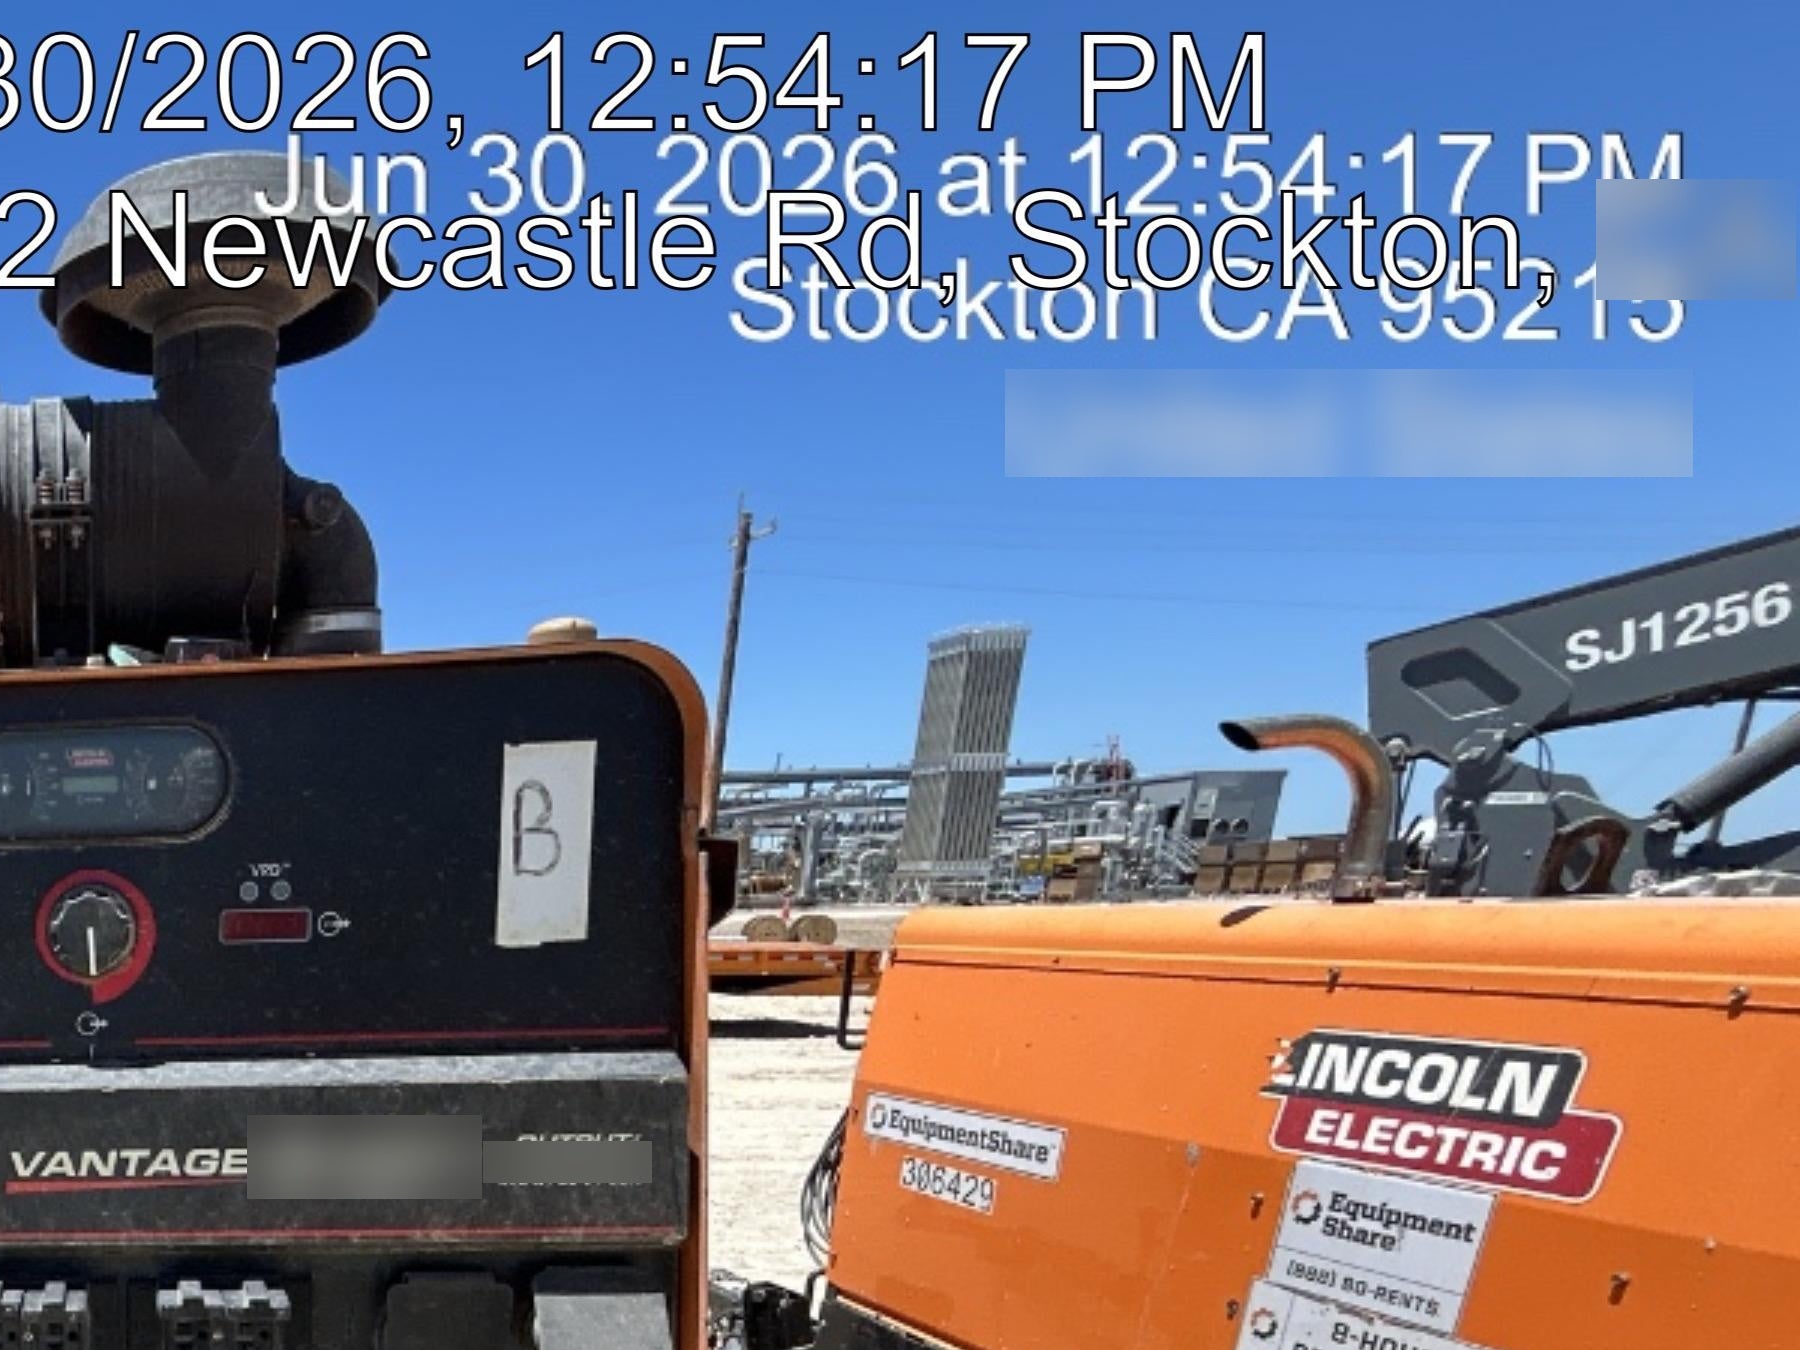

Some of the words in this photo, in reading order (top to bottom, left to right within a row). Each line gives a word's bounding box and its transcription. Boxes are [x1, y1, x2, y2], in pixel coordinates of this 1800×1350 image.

[1565, 581, 1792, 672] SJ1256
[513, 778, 562, 877] B
[10, 1148, 247, 1178] VANTAGE
[1304, 1108, 1567, 1182] ELECTRIC
[902, 1157, 994, 1213] 306429
[1321, 1215, 1396, 1251] Share
[1328, 1191, 1477, 1243] Equipment
